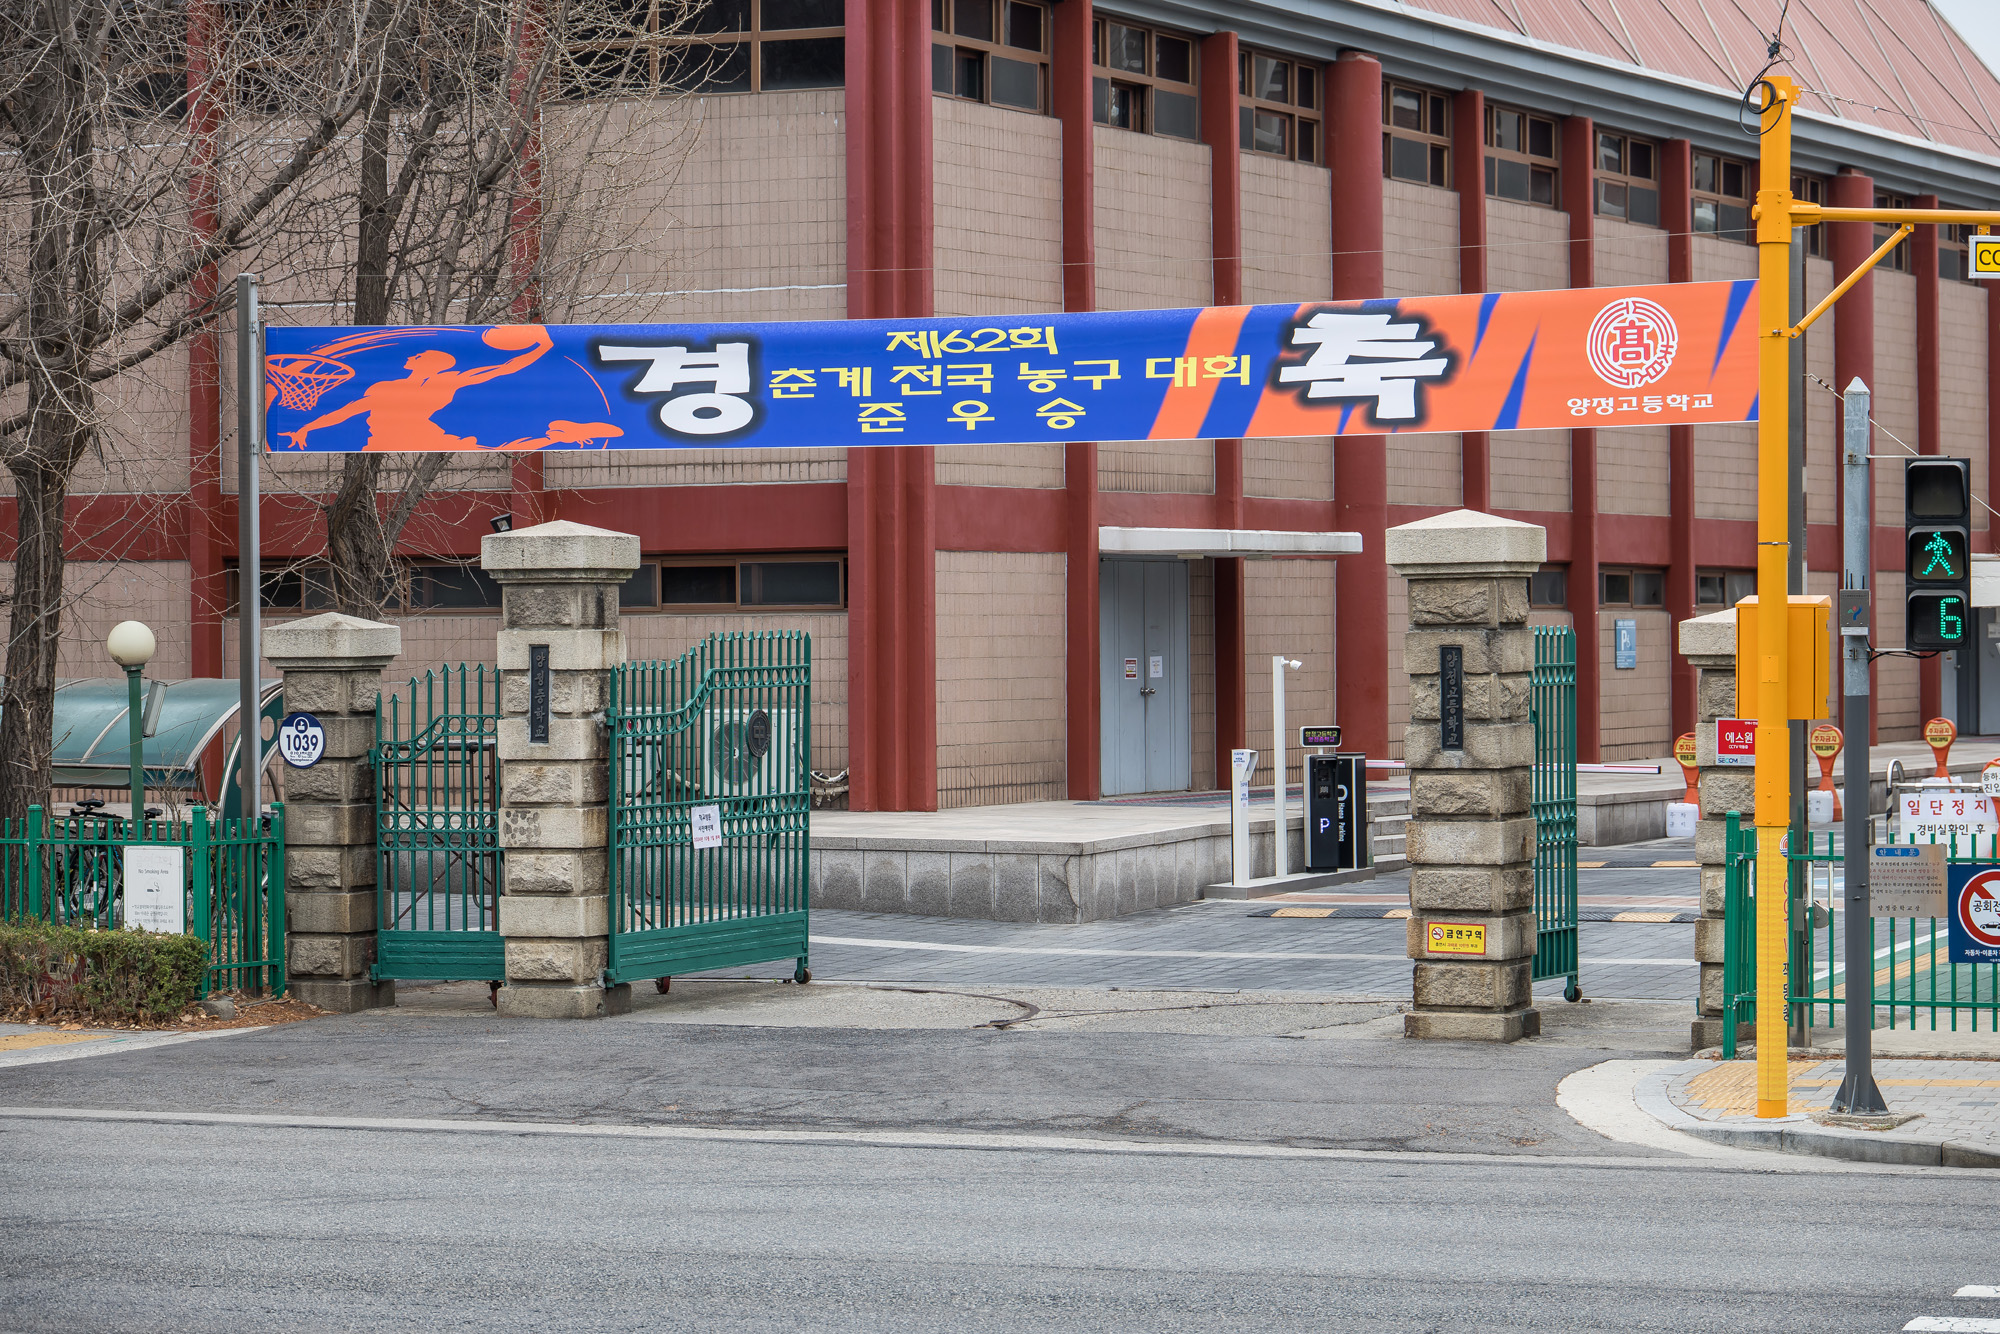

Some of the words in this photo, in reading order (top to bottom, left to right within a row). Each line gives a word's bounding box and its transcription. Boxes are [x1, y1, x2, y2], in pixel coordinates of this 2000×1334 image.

[886, 326, 1059, 359] 제62회
[769, 367, 872, 398] 춘계
[889, 363, 994, 396] 전국
[1017, 361, 1122, 393] 농구
[1146, 354, 1251, 388] 대회
[1279, 312, 1448, 419] 축
[599, 343, 754, 434] 경
[1567, 394, 1714, 416] 양정고등학교
[1940, 597, 1962, 639] 6
[534, 652, 546, 737] 양정중학교
[1446, 650, 1459, 745] 양정고등학교
[286, 733, 319, 751] 1039
[1725, 732, 1753, 744] 에스원
[1983, 772, 2000, 781] 등하
[1320, 817, 1330, 834] P
[1917, 824, 1969, 836] 경비실확인
[1975, 824, 1986, 834] 후
[1446, 929, 1482, 940] 금연구역
